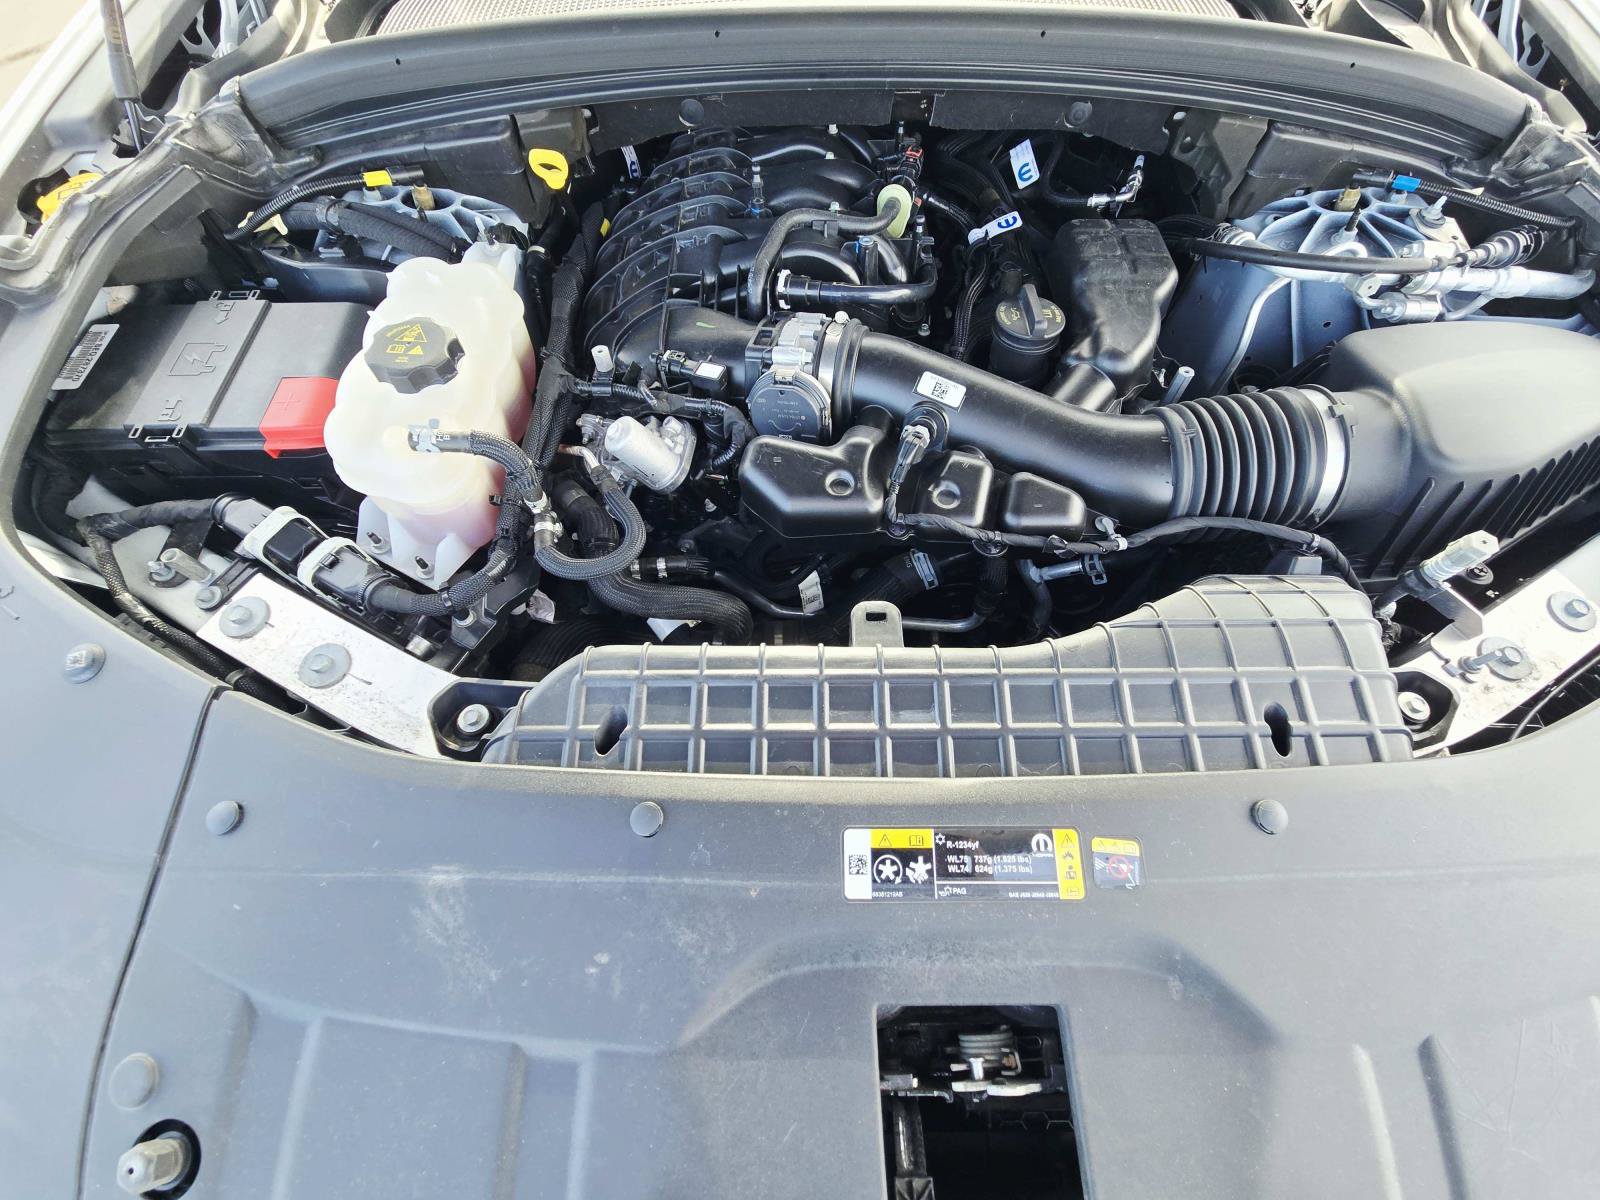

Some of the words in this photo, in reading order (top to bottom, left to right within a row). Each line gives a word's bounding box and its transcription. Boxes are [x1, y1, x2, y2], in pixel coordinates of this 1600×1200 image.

[946, 840, 980, 851] R-1234yf
[973, 854, 993, 865] 737g
[1017, 854, 1032, 865] lbs)
[947, 864, 970, 873] WL74
[974, 864, 993, 875] 624g
[994, 864, 1017, 875] (1.375
[1018, 864, 1033, 875] lbs)
[952, 887, 967, 895] PAG
